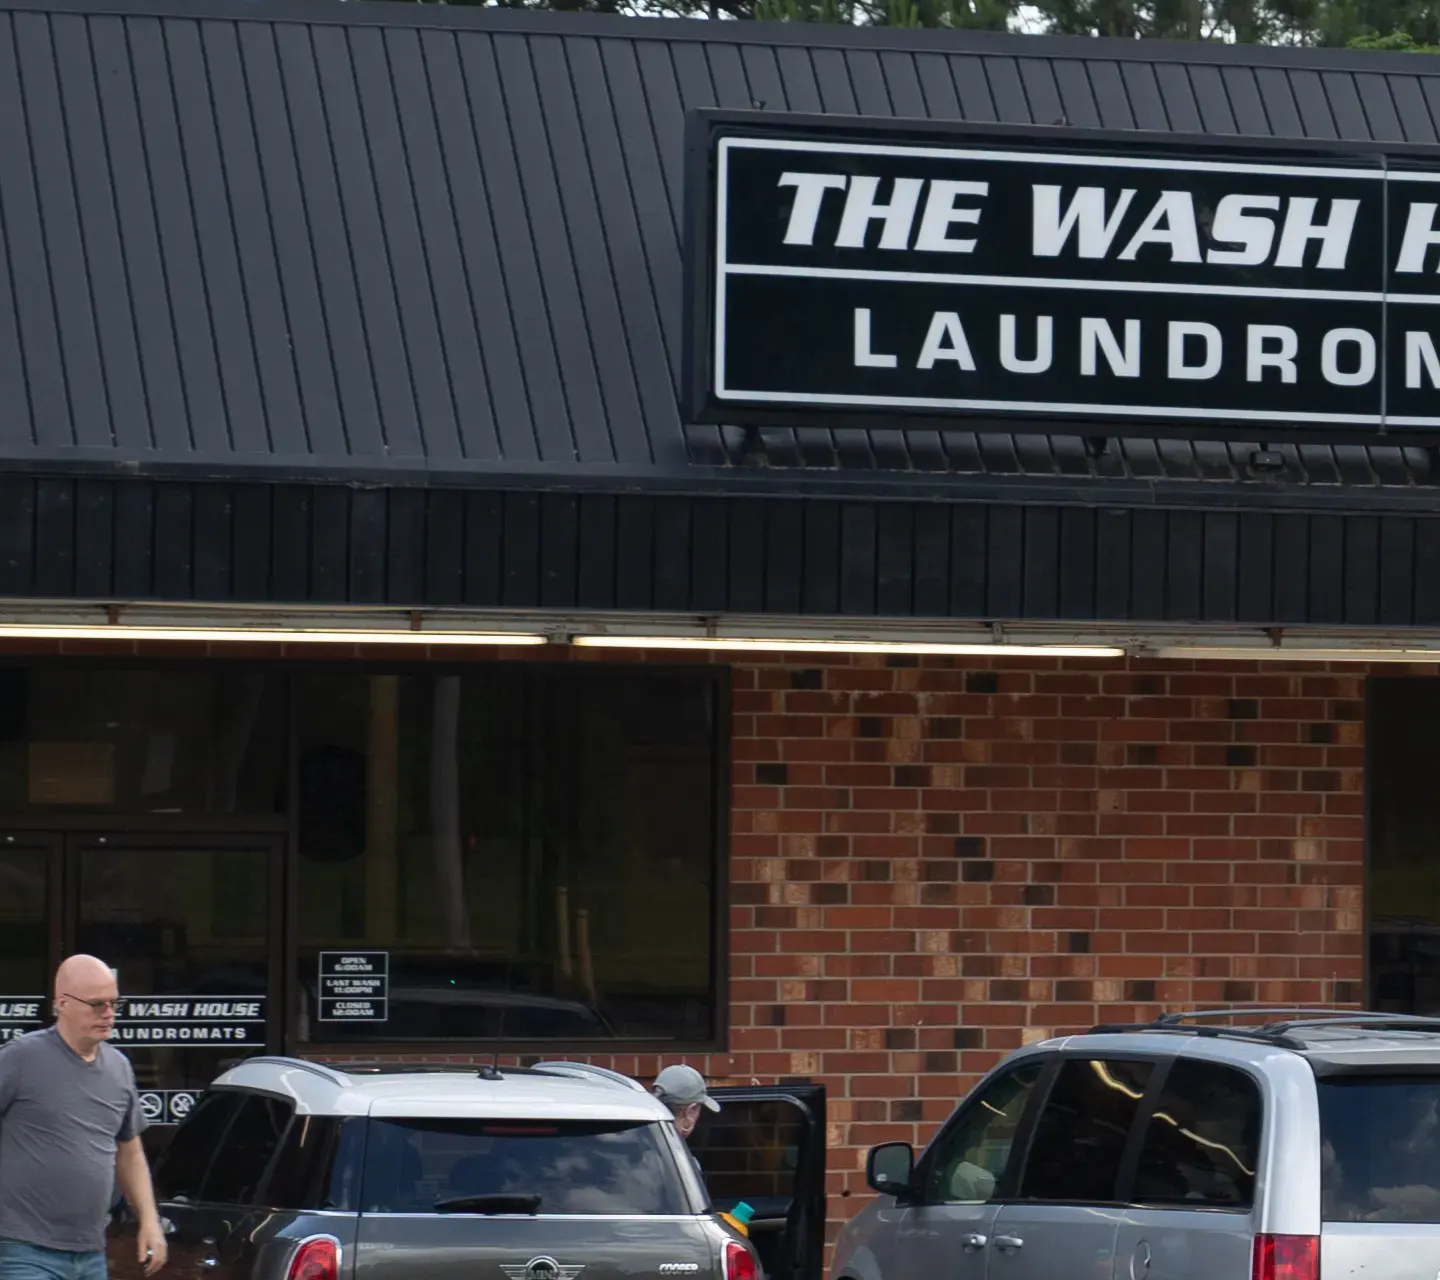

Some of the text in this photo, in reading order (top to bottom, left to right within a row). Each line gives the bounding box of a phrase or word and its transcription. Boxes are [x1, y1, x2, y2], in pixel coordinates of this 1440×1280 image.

[777, 171, 989, 253] THE
[1030, 184, 1361, 270] WASH
[129, 1003, 189, 1017] WASH
[192, 1002, 261, 1017] HOUSE
[109, 1027, 247, 1040] AUNDROMATS
